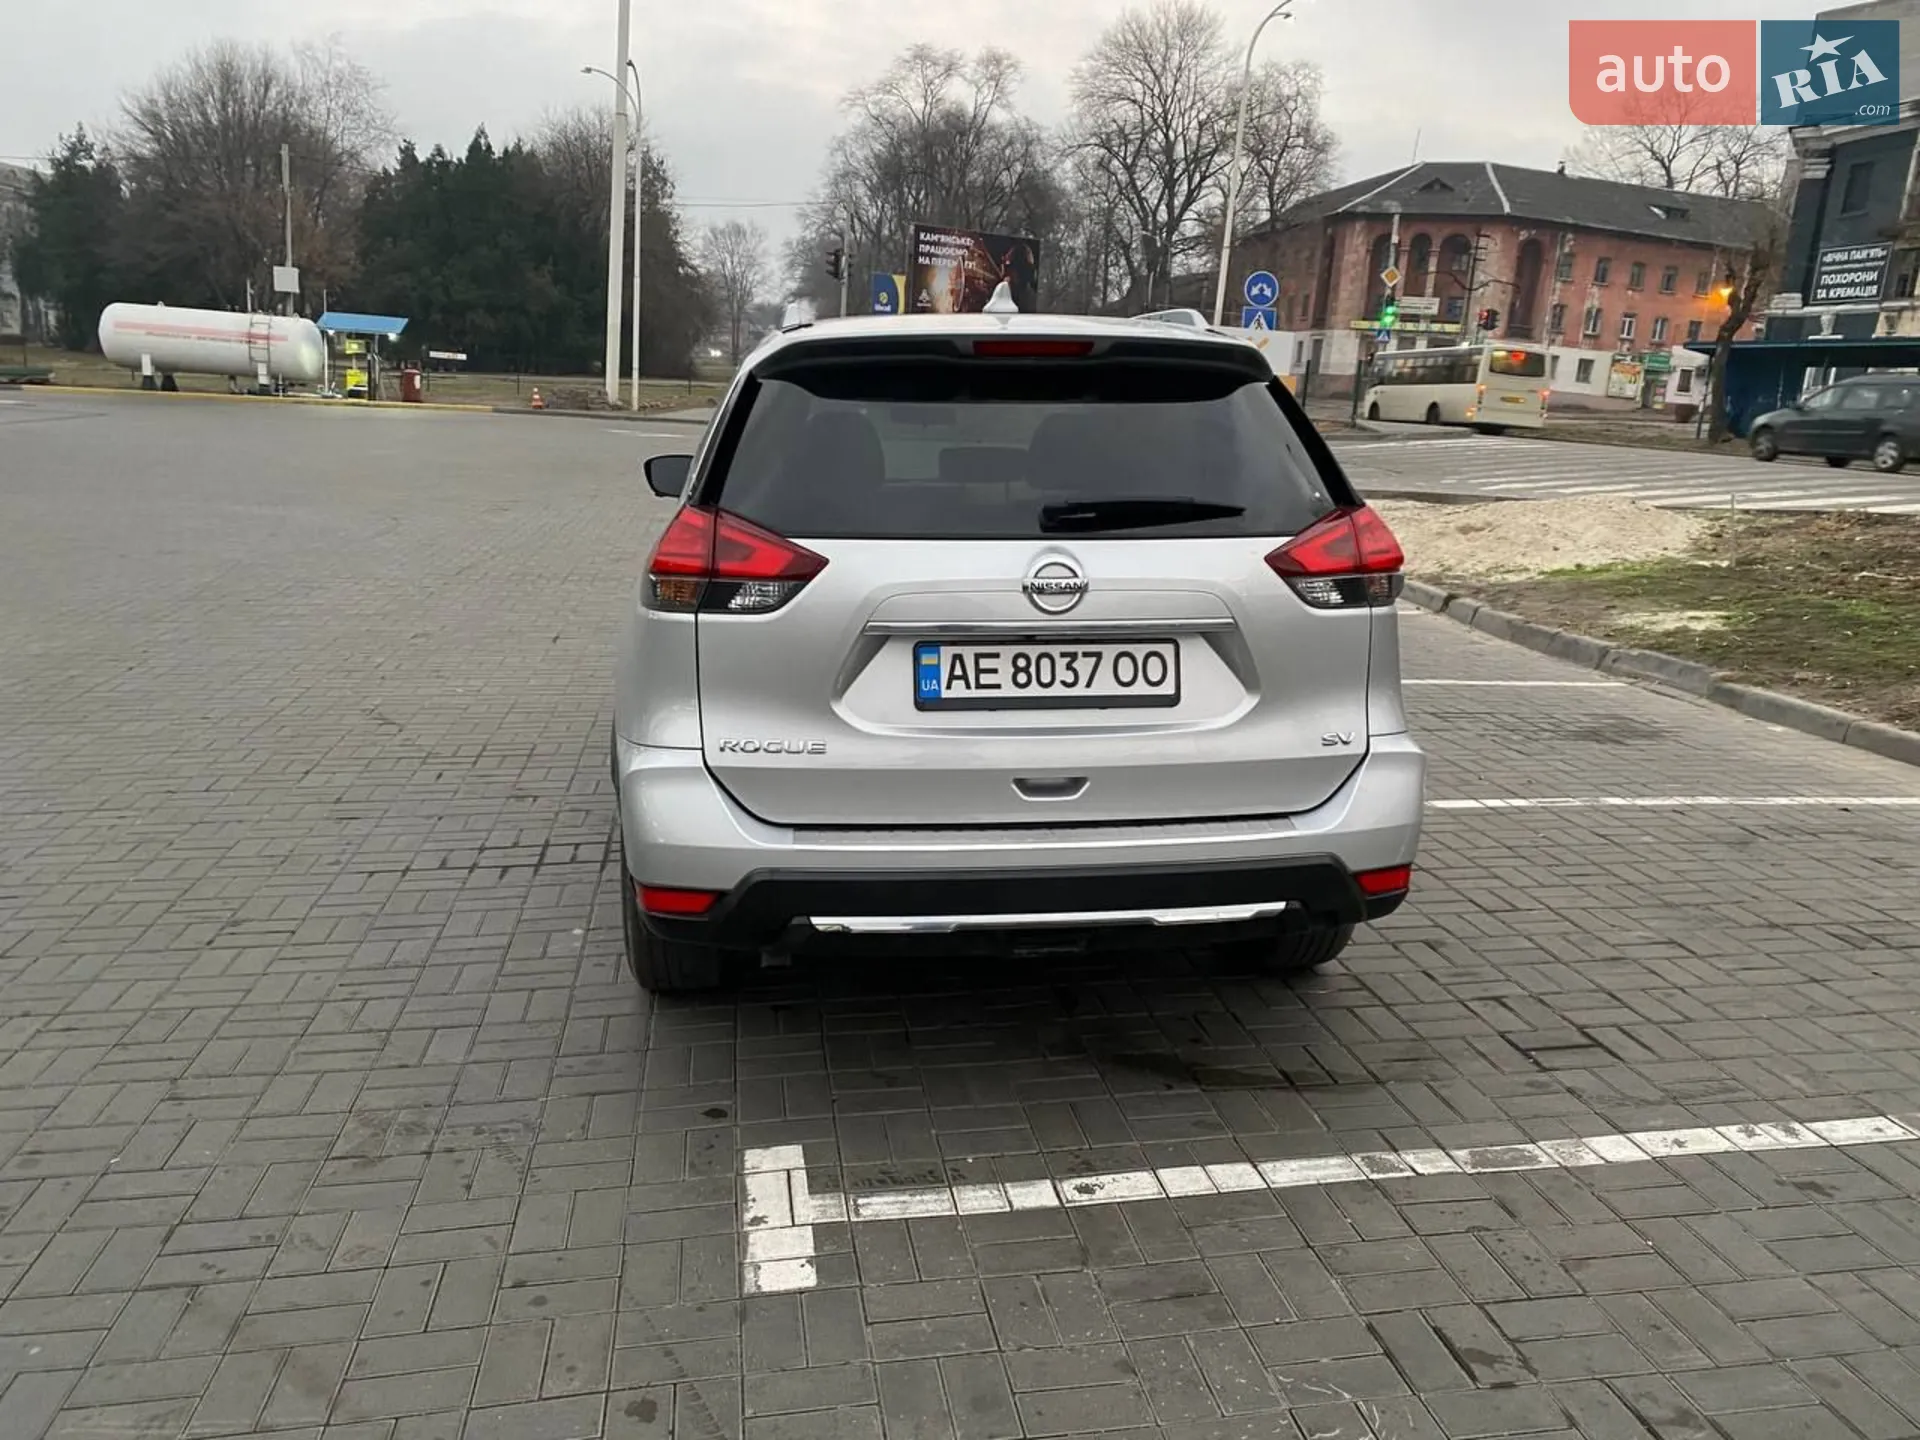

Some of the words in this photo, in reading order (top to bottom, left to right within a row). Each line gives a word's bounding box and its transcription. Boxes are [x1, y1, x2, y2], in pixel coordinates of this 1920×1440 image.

[918, 256, 931, 265] НА
[1820, 270, 1879, 286] ПОХОРОНИ
[1816, 288, 1827, 299] ТА
[1828, 285, 1879, 298] КРЕМАЦІЯ
[1029, 580, 1083, 592] NISSAN
[945, 652, 1002, 691] AE
[1011, 650, 1103, 690] 8037
[921, 679, 939, 691] UA
[719, 738, 828, 755] ROGUE
[1320, 731, 1356, 747] SV
